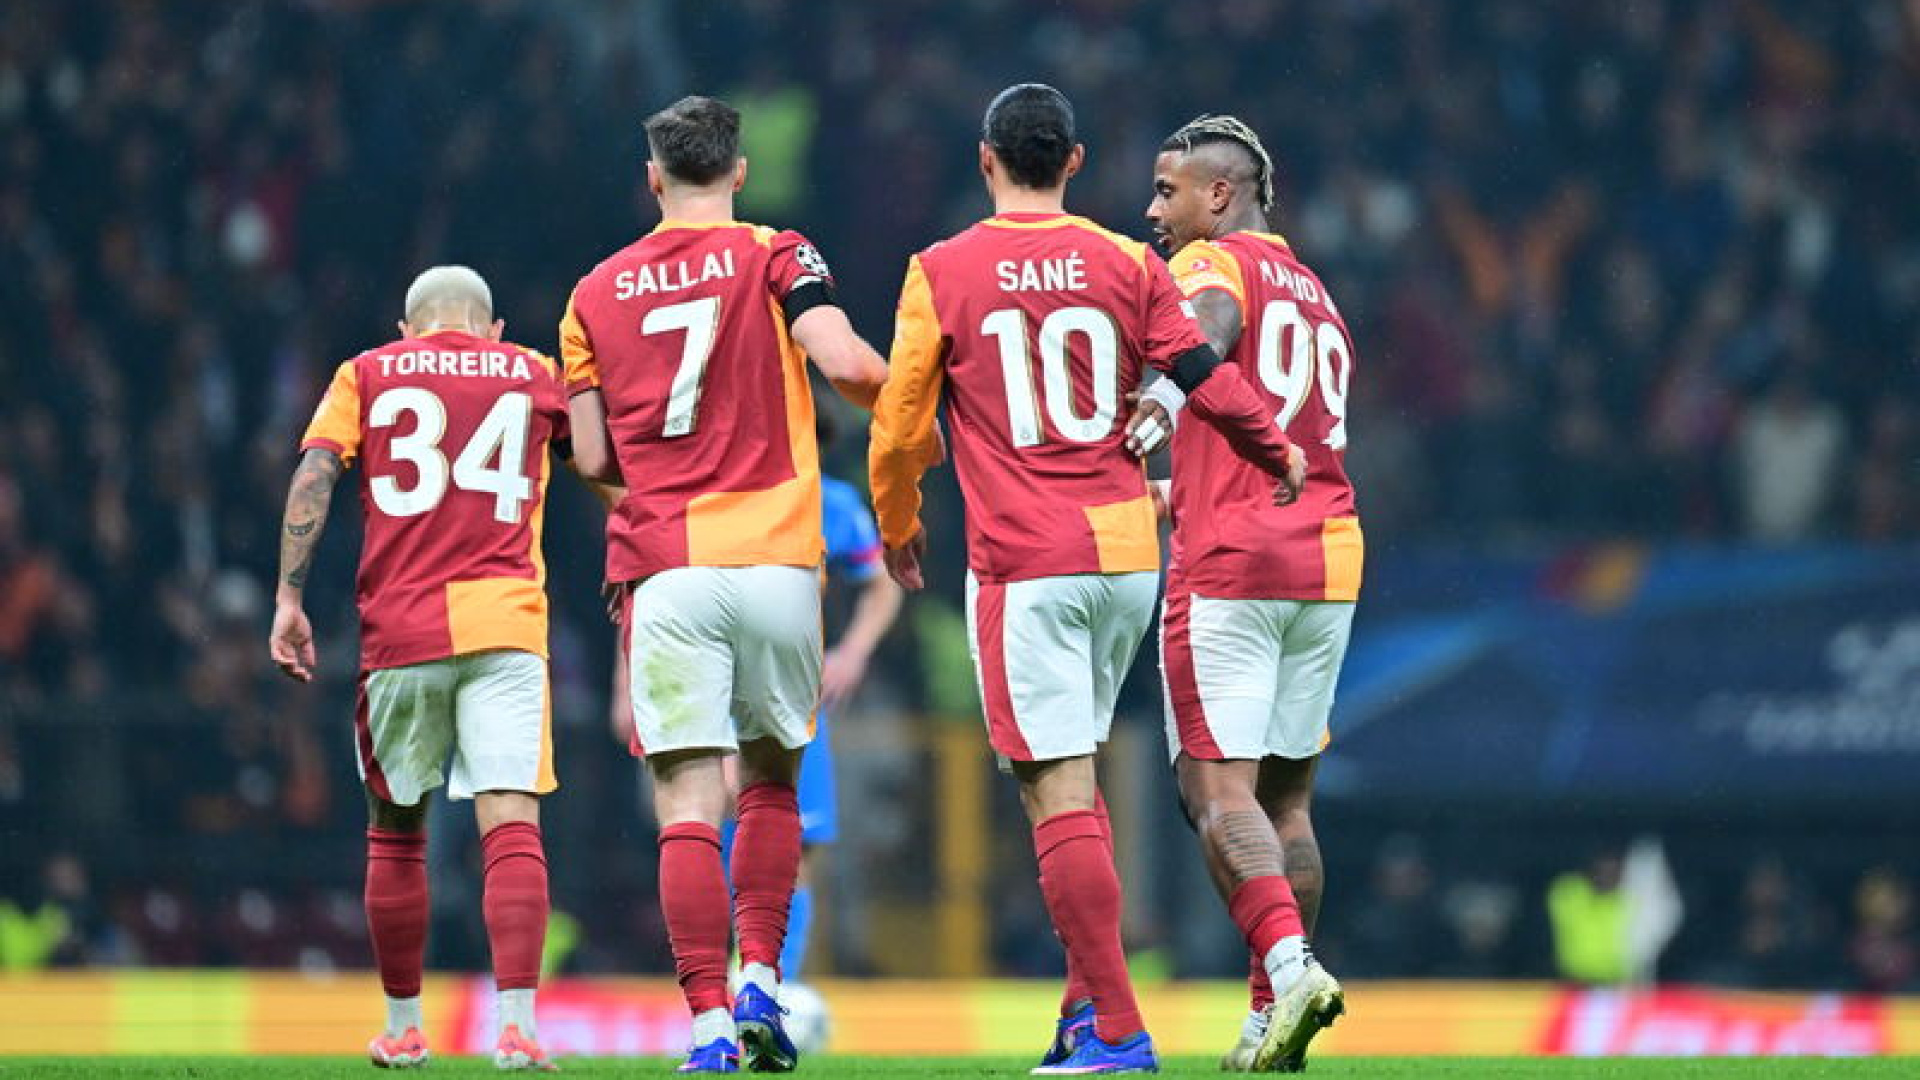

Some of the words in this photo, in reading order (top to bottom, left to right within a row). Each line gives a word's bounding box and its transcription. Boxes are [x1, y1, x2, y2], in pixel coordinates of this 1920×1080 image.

[615, 249, 735, 300] SALLAI
[996, 250, 1088, 292] SANÉ
[377, 351, 533, 380] TORREIRA
[641, 295, 721, 437] 7
[980, 306, 1119, 448] 10
[1257, 299, 1350, 450] 99
[369, 386, 534, 523] 34
